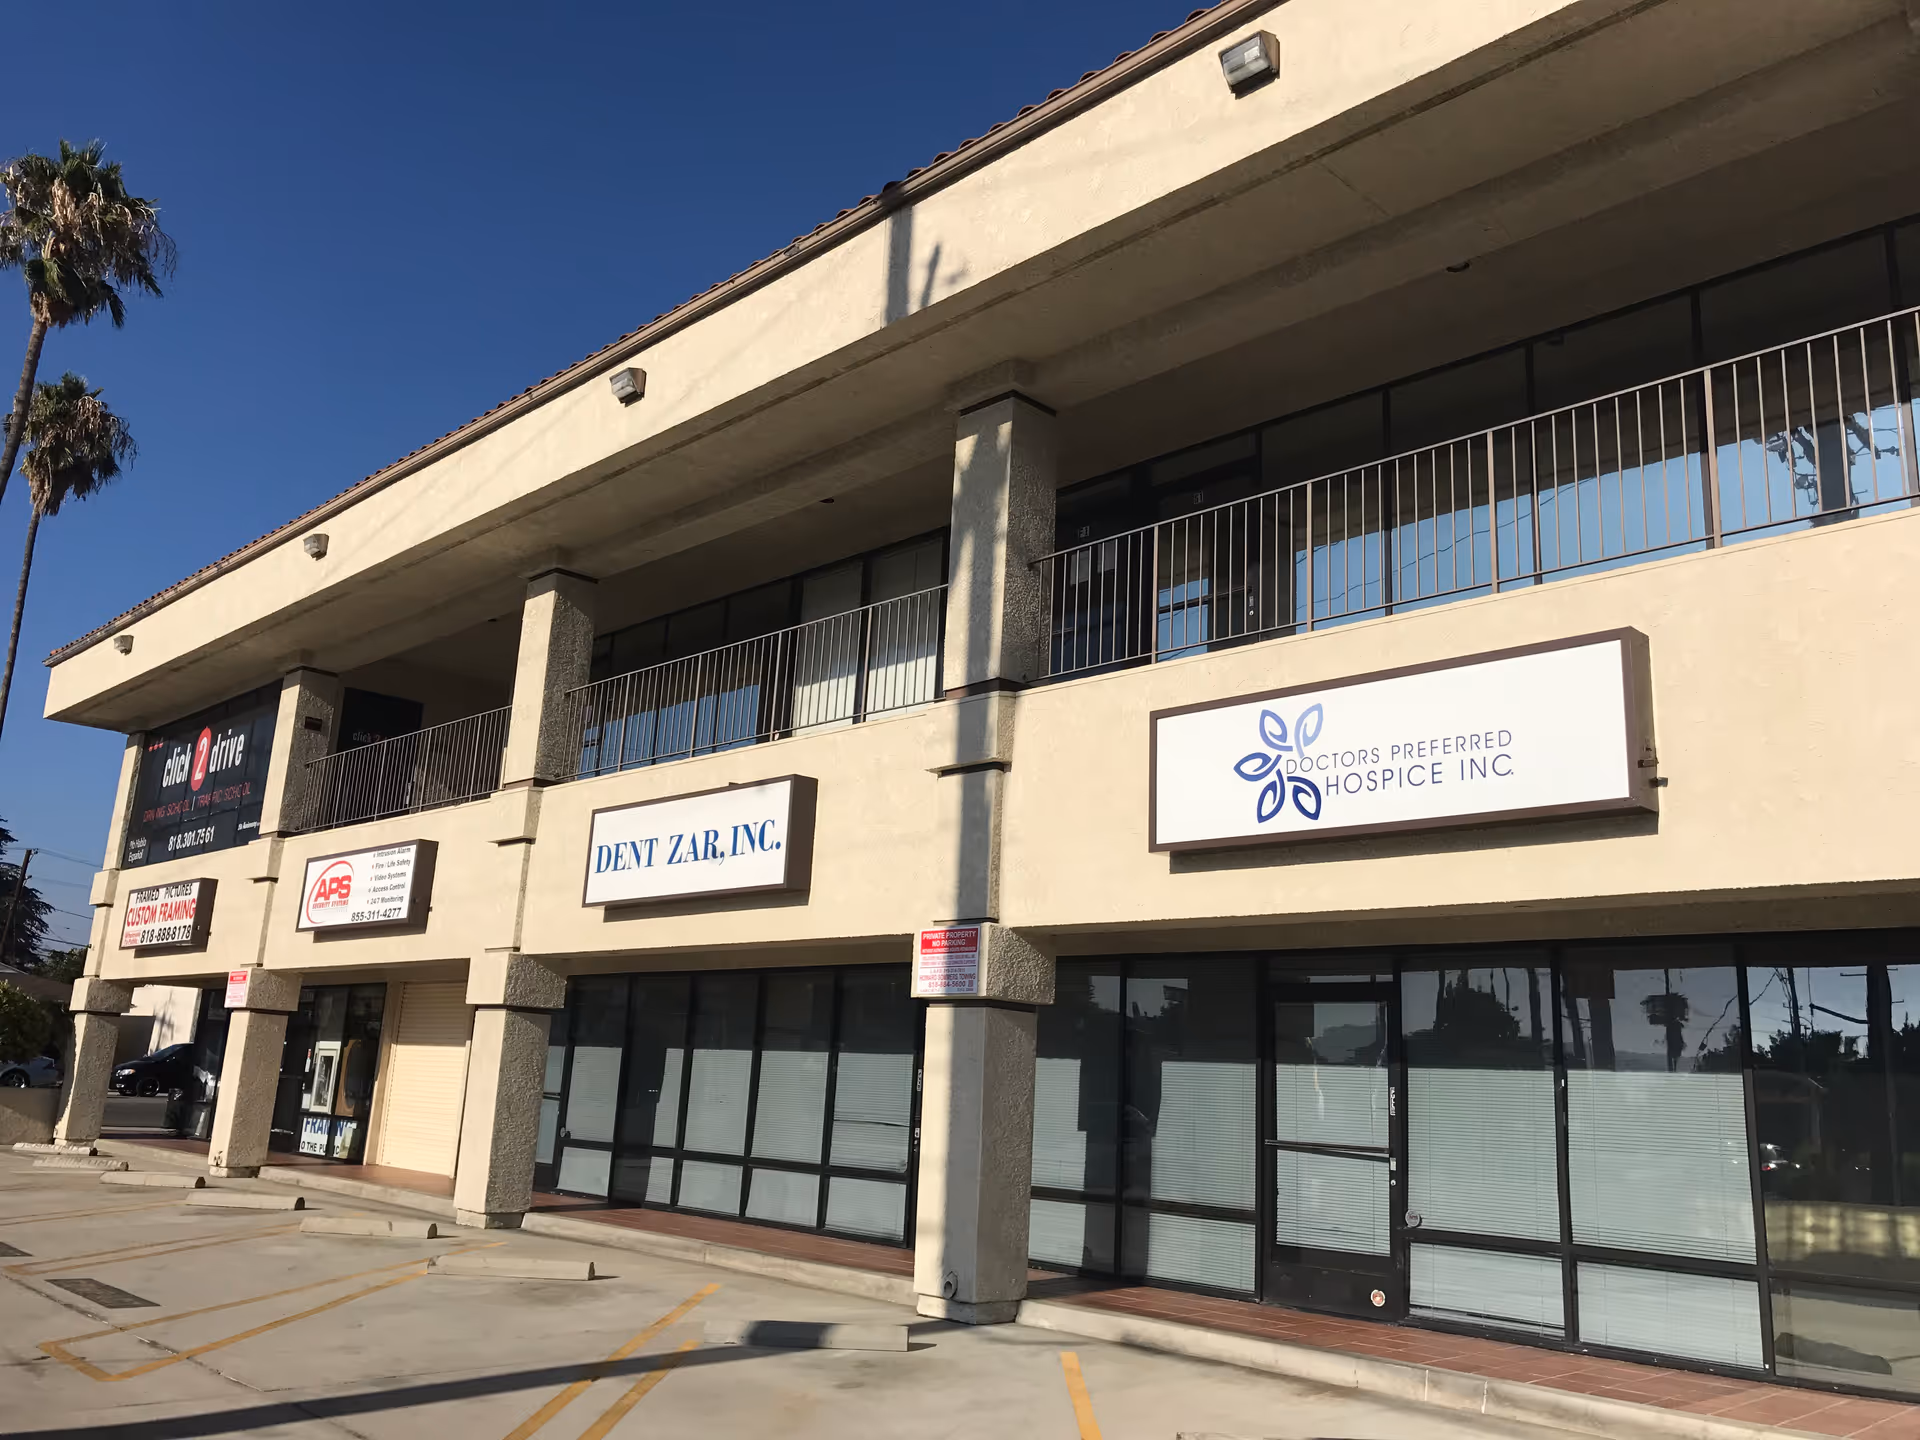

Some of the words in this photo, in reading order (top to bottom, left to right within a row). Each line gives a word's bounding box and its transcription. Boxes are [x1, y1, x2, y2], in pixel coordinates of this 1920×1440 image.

[163, 743, 191, 788] click
[194, 737, 208, 781] 2
[209, 729, 245, 773] drive
[1286, 747, 1380, 775] DOCTORS
[1391, 729, 1513, 762] PREFERRED
[1325, 762, 1443, 797] HOSPICE
[1459, 753, 1515, 781] INC.
[168, 826, 215, 852] 818.301.7561
[594, 837, 659, 874] DENT
[667, 828, 725, 866] ZAR,
[729, 819, 782, 857] INC.
[376, 849, 396, 857] Intrusion
[387, 871, 406, 880] Systems
[135, 888, 160, 904] FRAMED
[164, 883, 193, 900] PICTURES
[313, 875, 352, 902] APS
[389, 882, 406, 891] Control
[127, 904, 158, 927] CUSTOM
[158, 898, 196, 923] FRAMING
[351, 907, 402, 922] 855-311-4277
[922, 932, 946, 940] PRIVATE
[946, 930, 976, 939] PROPERTY
[941, 939, 966, 947] PARKING
[307, 1142, 318, 1152] THE
